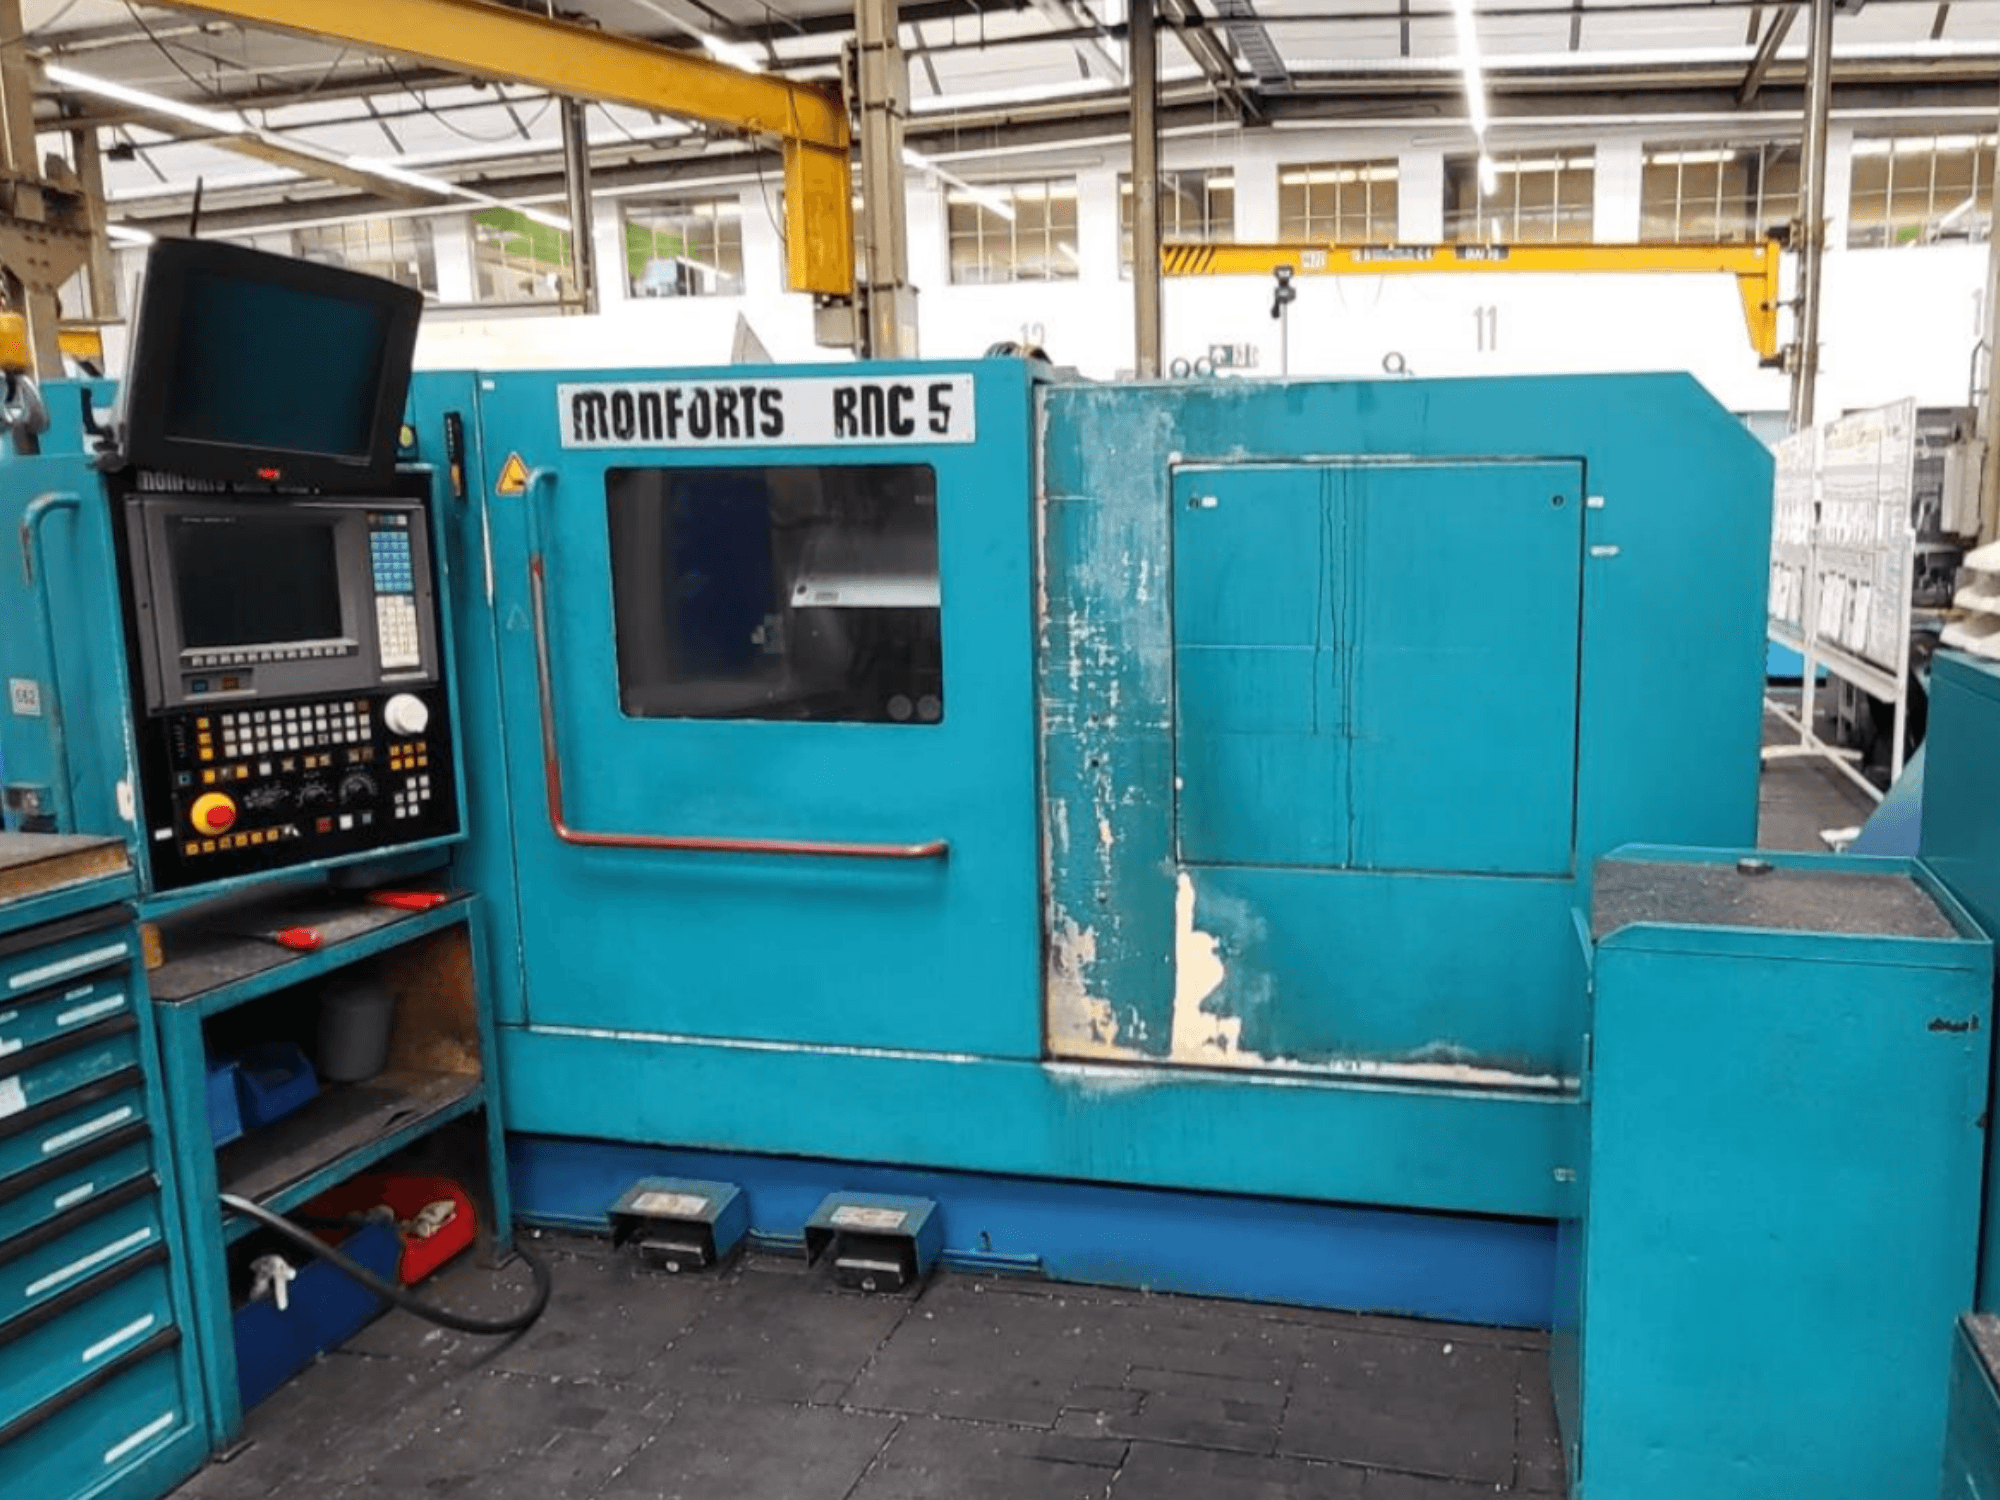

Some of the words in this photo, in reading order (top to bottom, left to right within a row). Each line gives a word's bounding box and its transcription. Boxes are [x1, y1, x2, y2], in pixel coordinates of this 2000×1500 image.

[1472, 305, 1497, 352] 11
[572, 385, 785, 442] MONFORTS
[832, 383, 915, 439] RNC
[927, 383, 954, 435] 5
